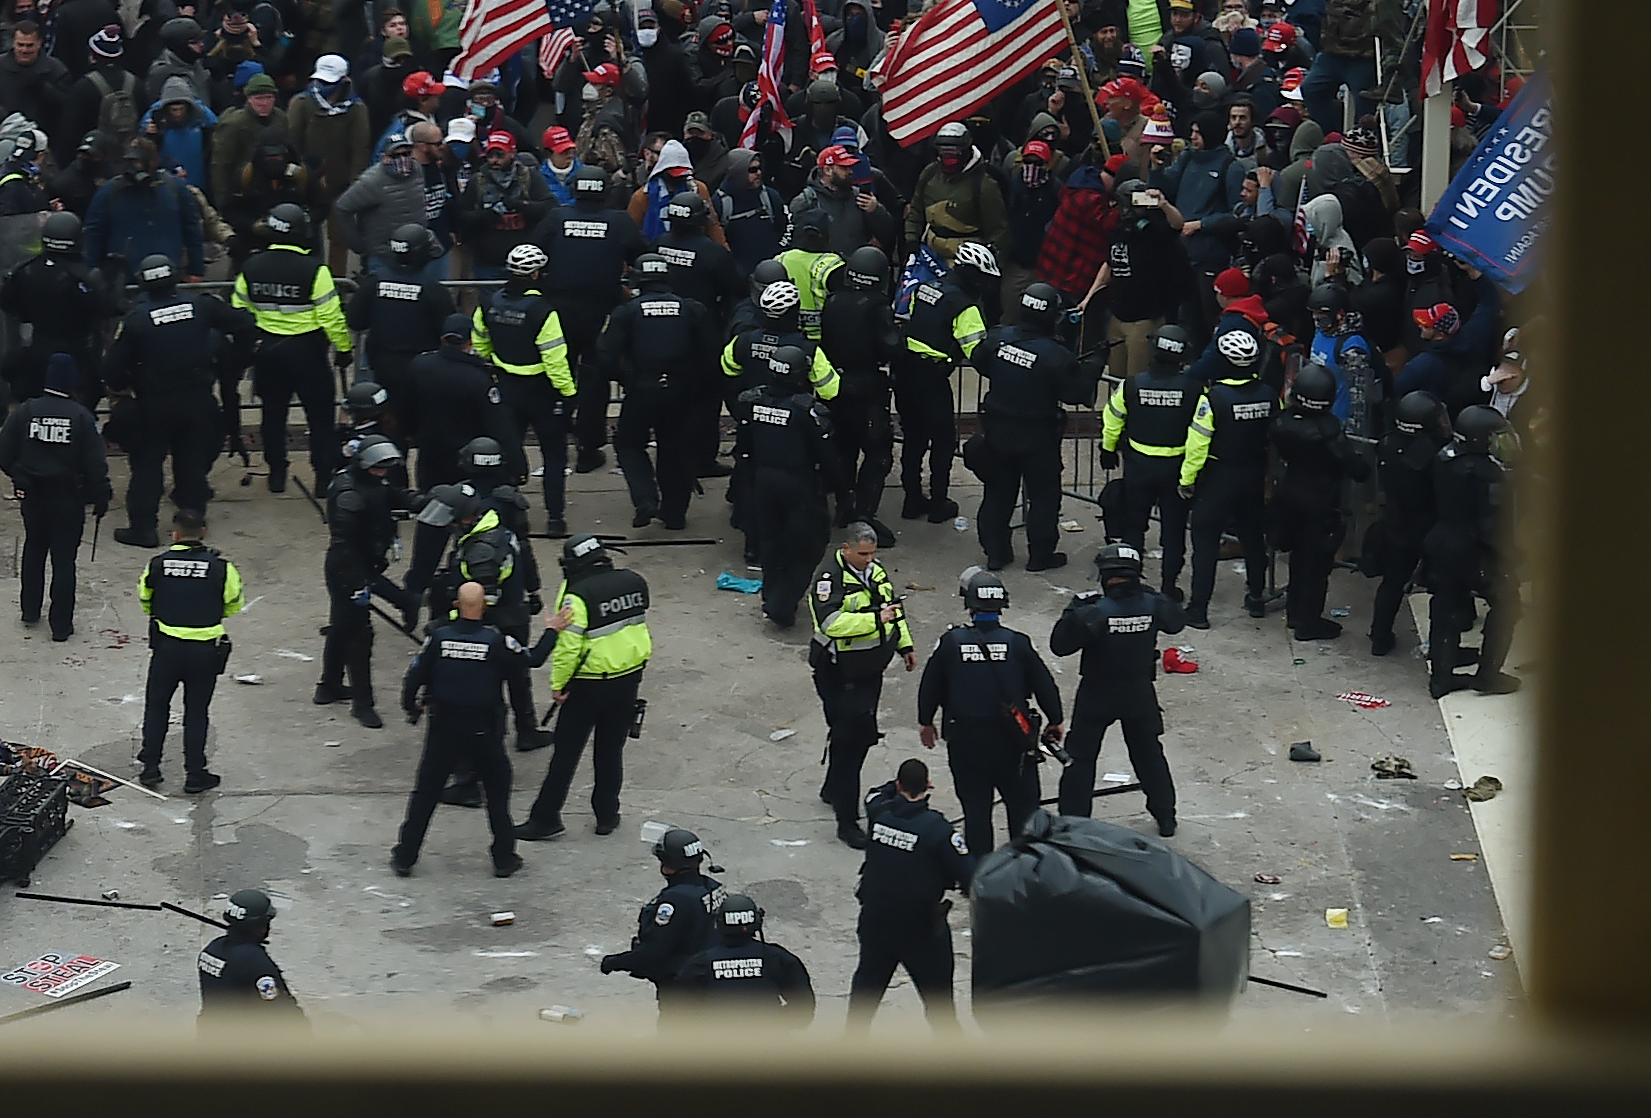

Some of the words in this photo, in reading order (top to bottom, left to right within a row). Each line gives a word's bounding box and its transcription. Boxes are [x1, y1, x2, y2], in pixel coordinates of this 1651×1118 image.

[577, 179, 603, 191] MPDC
[565, 229, 607, 238] POLICE
[852, 277, 873, 285] POLICE
[252, 283, 300, 297] POLICE
[380, 290, 419, 300] POLICE
[917, 292, 936, 305] POLICE
[1022, 293, 1048, 310] MPDC
[153, 310, 194, 325] POLICE
[644, 308, 680, 316] POLICE
[1157, 337, 1185, 353] MPDC
[751, 351, 771, 359] POL
[997, 348, 1033, 369] POLICE
[1141, 398, 1181, 406] POLICE
[753, 413, 788, 425] POLICE
[1235, 409, 1269, 420] POLICE
[30, 423, 71, 443] POLICE
[600, 592, 644, 616] POLICE
[1109, 623, 1151, 633] POLICE
[441, 650, 487, 660] POLICE
[872, 832, 914, 851] POLICE
[725, 911, 754, 925] MPDC
[2, 953, 61, 984] STOP
[713, 959, 762, 970] METROPOLITAN
[28, 959, 100, 991] STEAL
[715, 968, 762, 978] POLICE
